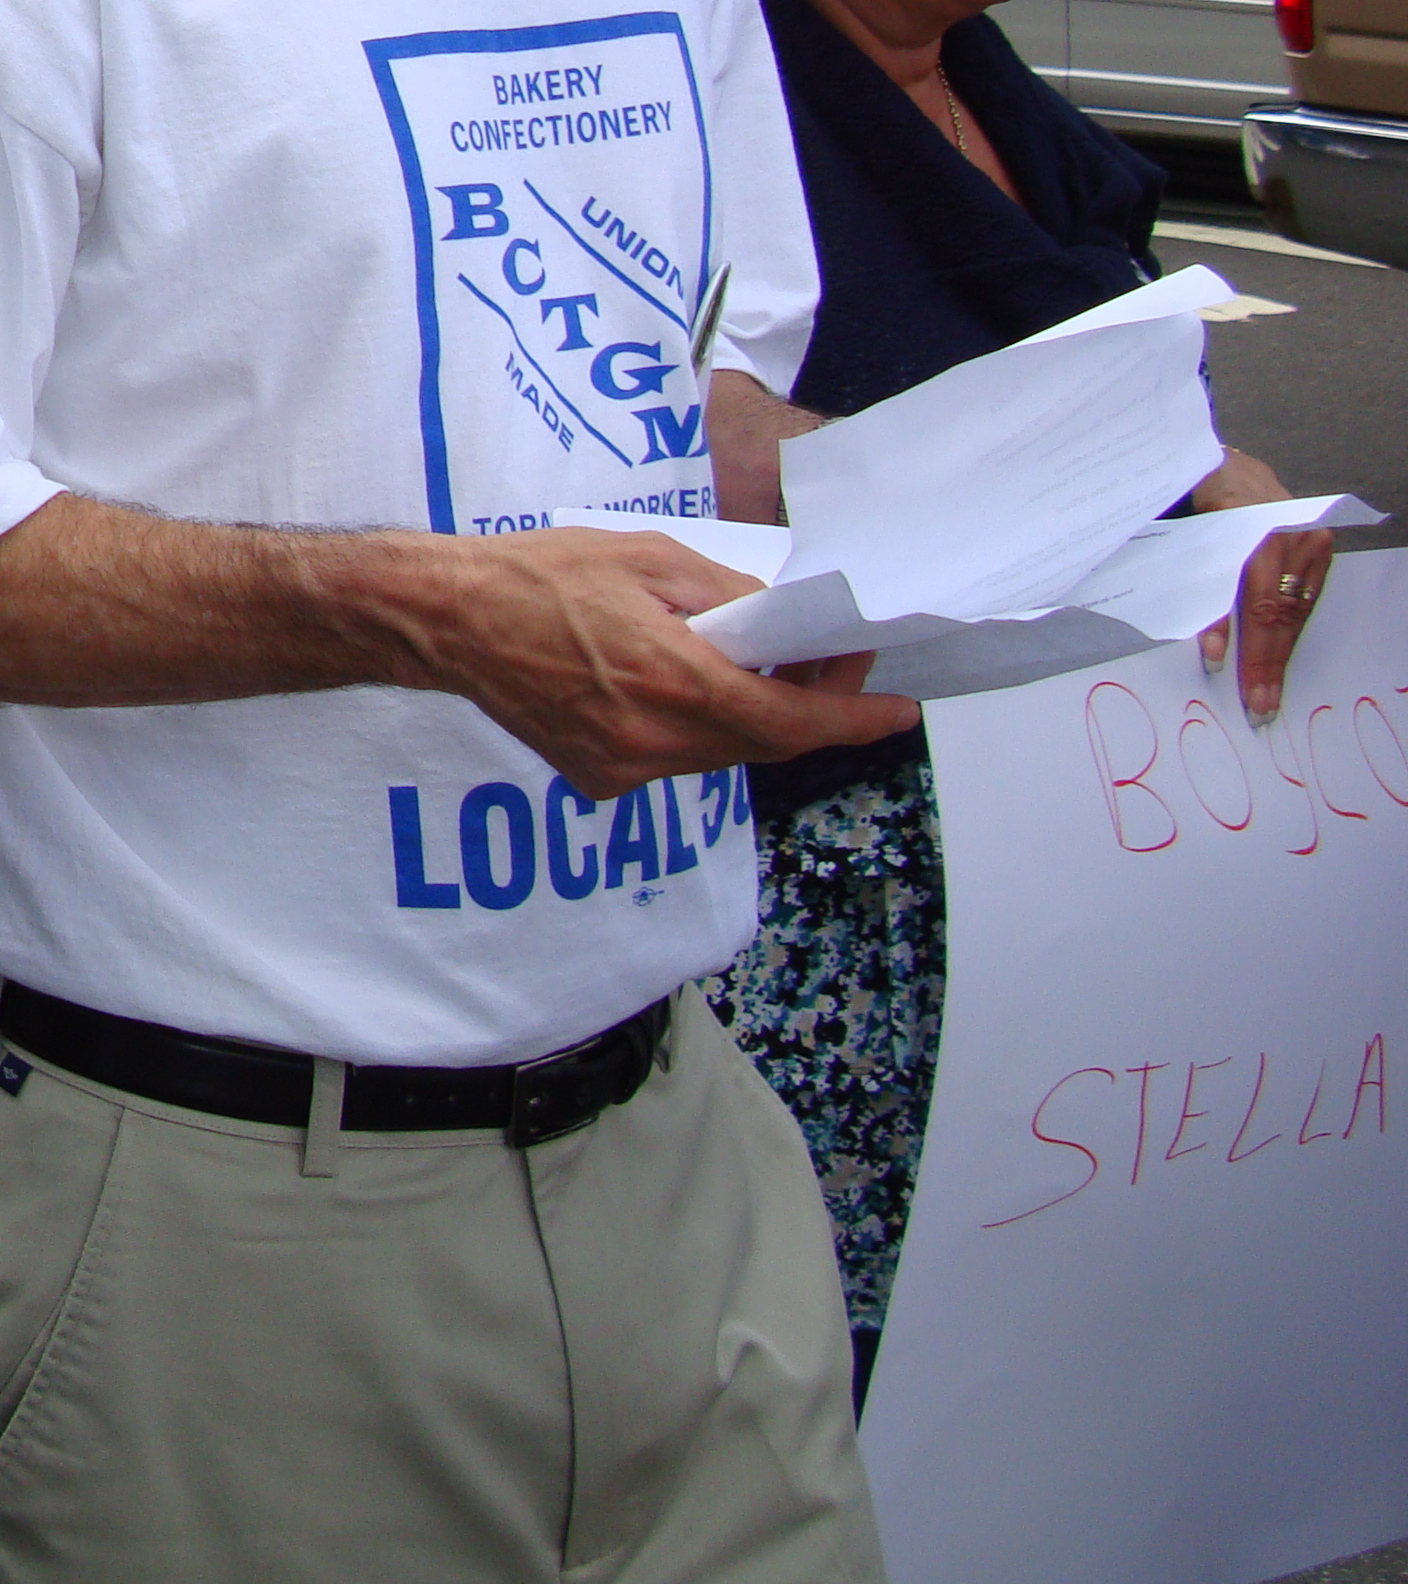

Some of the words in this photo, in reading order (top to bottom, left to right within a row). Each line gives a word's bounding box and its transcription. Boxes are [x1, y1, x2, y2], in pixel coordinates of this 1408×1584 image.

[450, 101, 674, 153] CONFECTIONERY
[492, 64, 604, 106] BAKERY
[580, 195, 685, 301] UNION
[505, 350, 576, 453] MADE
[603, 485, 718, 519] ORKER
[1085, 681, 1408, 856] BOYCO
[387, 774, 700, 911] LOCAL
[979, 1030, 1387, 1230] STELLA
